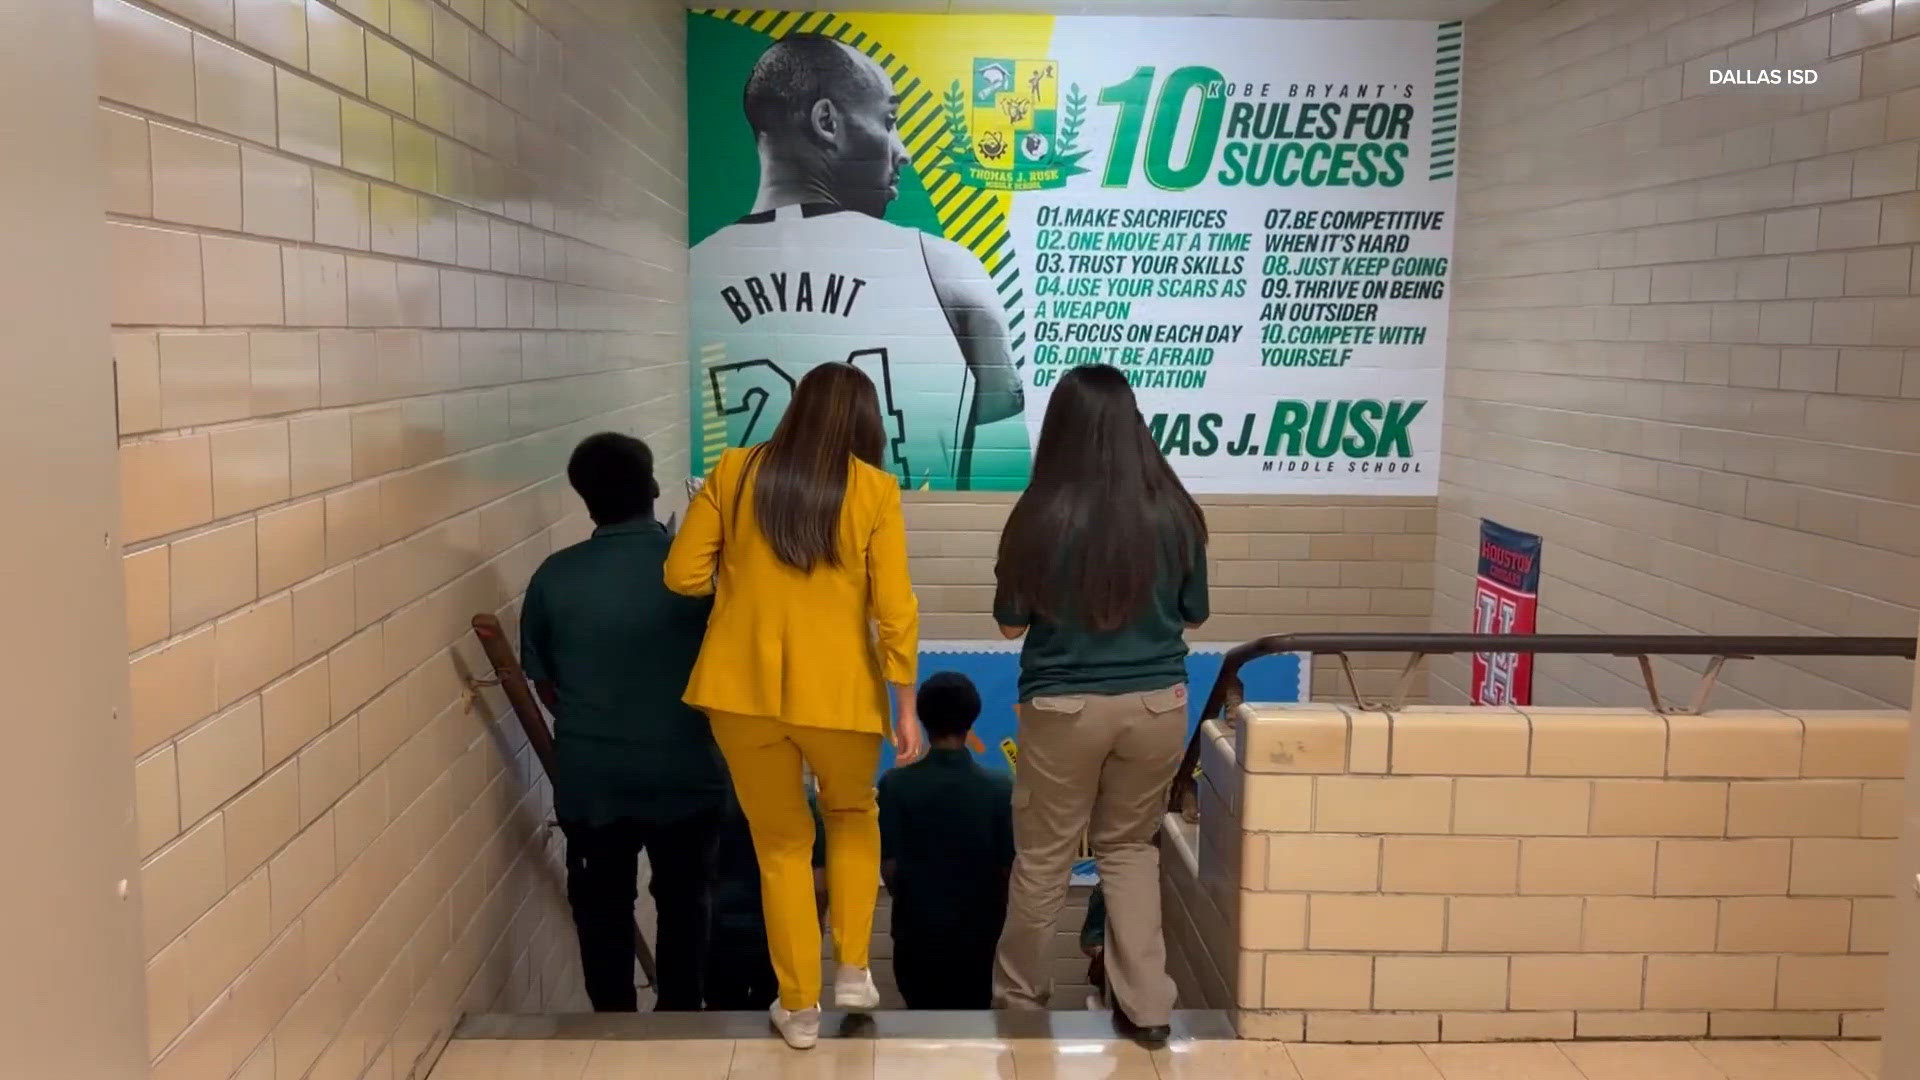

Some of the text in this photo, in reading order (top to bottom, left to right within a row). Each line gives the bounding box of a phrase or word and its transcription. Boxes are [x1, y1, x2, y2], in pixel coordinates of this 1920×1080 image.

[1207, 82, 1414, 99] KOBE BRYANT'S
[1097, 65, 1226, 192] 10
[1226, 102, 1414, 140] RULES FOR
[1218, 142, 1409, 187] SUCCESS
[969, 168, 1013, 182] THOMAS
[1029, 168, 1059, 181] RUSK
[1121, 209, 1228, 229] SACRIFICES
[1320, 210, 1445, 231] COMPETITIVE
[1106, 231, 1161, 251] MOVE
[1163, 233, 1188, 251] AT
[1189, 233, 1202, 251] A
[1208, 232, 1253, 252] TIME
[1265, 233, 1410, 254] WHEN IT'S HARD
[1131, 255, 1181, 275] YOUR
[1182, 255, 1245, 275] SKILLS
[1341, 257, 1390, 277] KEEP
[1391, 257, 1448, 278] GOING
[720, 271, 867, 325] BRYANT
[1107, 278, 1154, 298] YOUR
[1157, 278, 1220, 298] SCARS
[1221, 279, 1247, 298] AS
[1362, 280, 1388, 300] ON
[1390, 280, 1445, 300] BEING
[1034, 301, 1132, 320] A WEAPON
[1259, 303, 1379, 322] AN OUTSIDER
[1126, 324, 1153, 343] ON
[1155, 325, 1204, 344] EACH
[1205, 325, 1243, 344] DAY
[1379, 326, 1427, 345] WITH
[1120, 347, 1144, 366] BE
[1145, 347, 1215, 367] AFRAID
[1260, 348, 1353, 367] YOURSELF
[1033, 368, 1057, 388] OF
[1148, 399, 1428, 459] MAS J. RUSK
[1262, 461, 1422, 474] MIDDLE SCHOOL
[1481, 541, 1533, 574] HOUSTON
